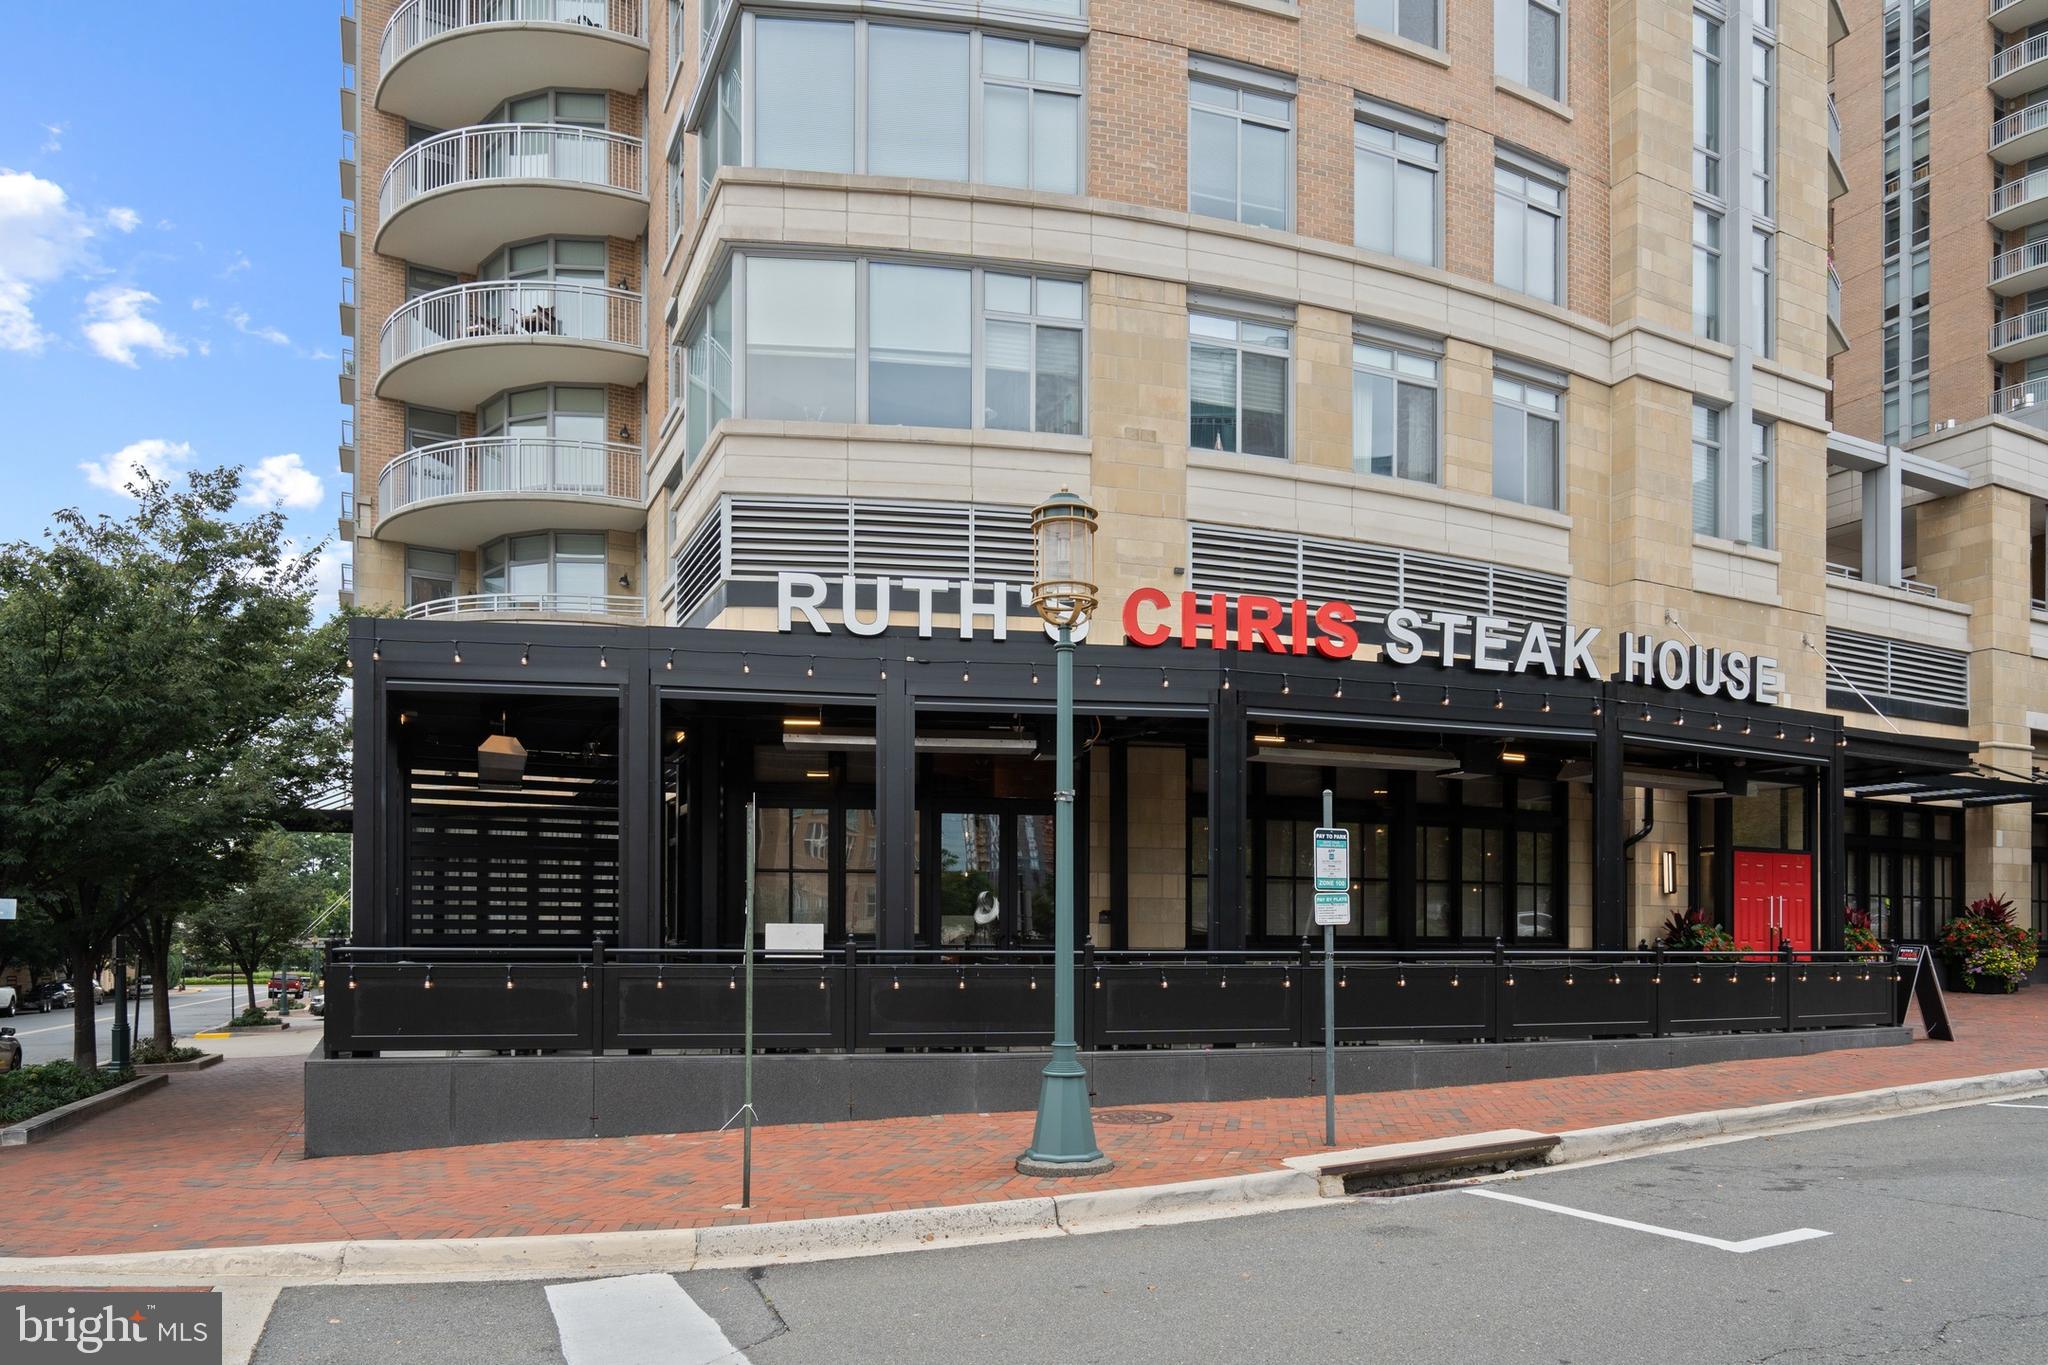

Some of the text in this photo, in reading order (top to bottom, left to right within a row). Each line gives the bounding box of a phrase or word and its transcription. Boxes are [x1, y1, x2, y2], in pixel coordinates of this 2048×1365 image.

[1122, 587, 1359, 659] CHRIS
[1383, 608, 1601, 680] STEAK
[1617, 631, 1778, 705] HOUSE
